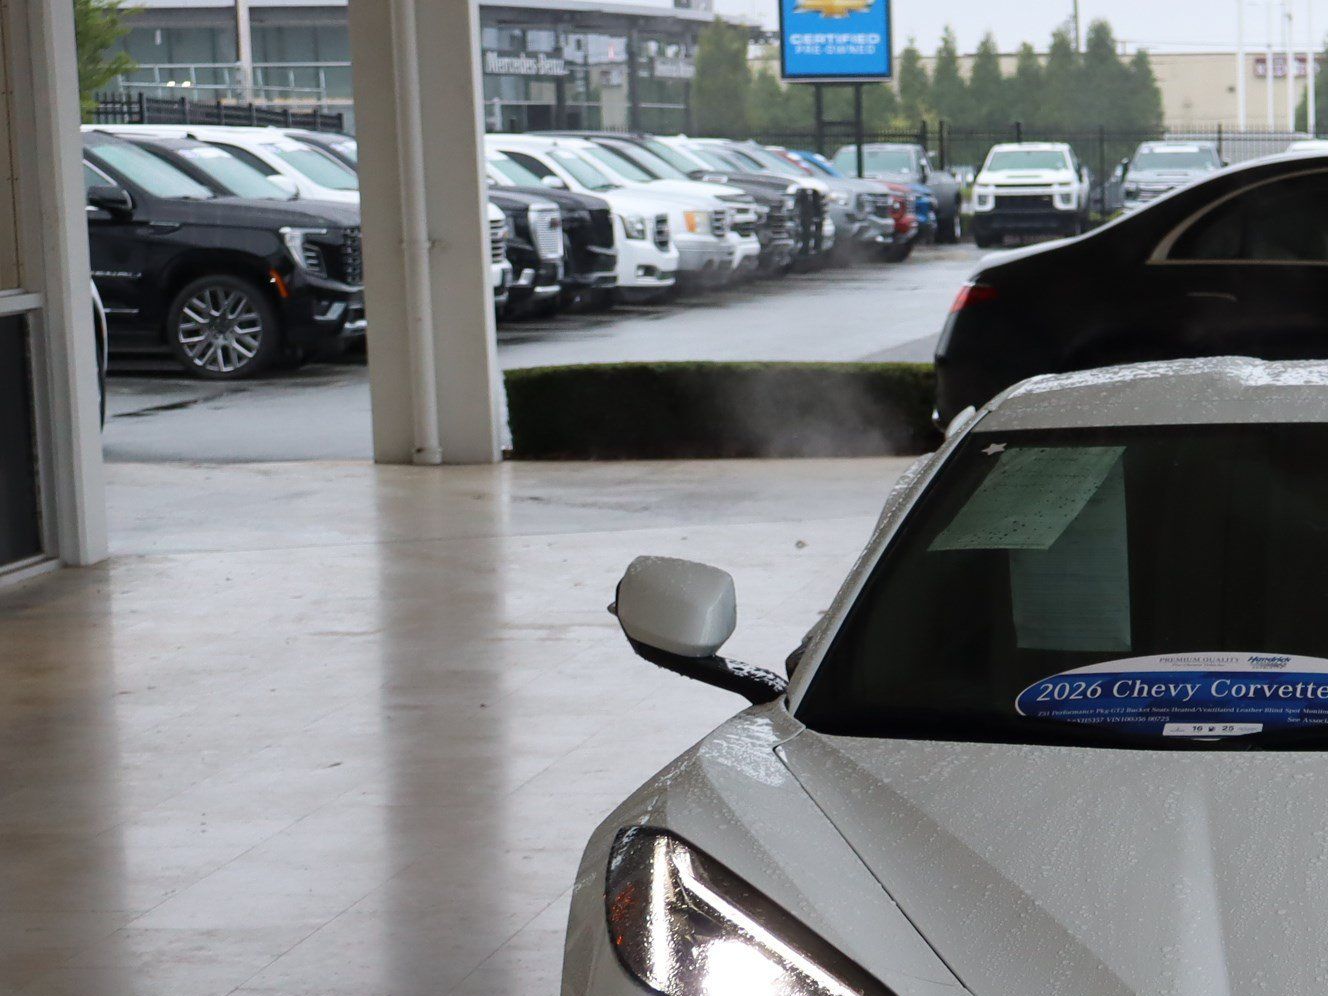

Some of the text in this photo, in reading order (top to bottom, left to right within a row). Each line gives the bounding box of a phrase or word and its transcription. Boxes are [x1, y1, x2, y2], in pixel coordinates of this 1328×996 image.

[789, 33, 881, 45] CERTIFIED
[1036, 680, 1103, 701] 2026
[1112, 679, 1200, 702] Chevy
